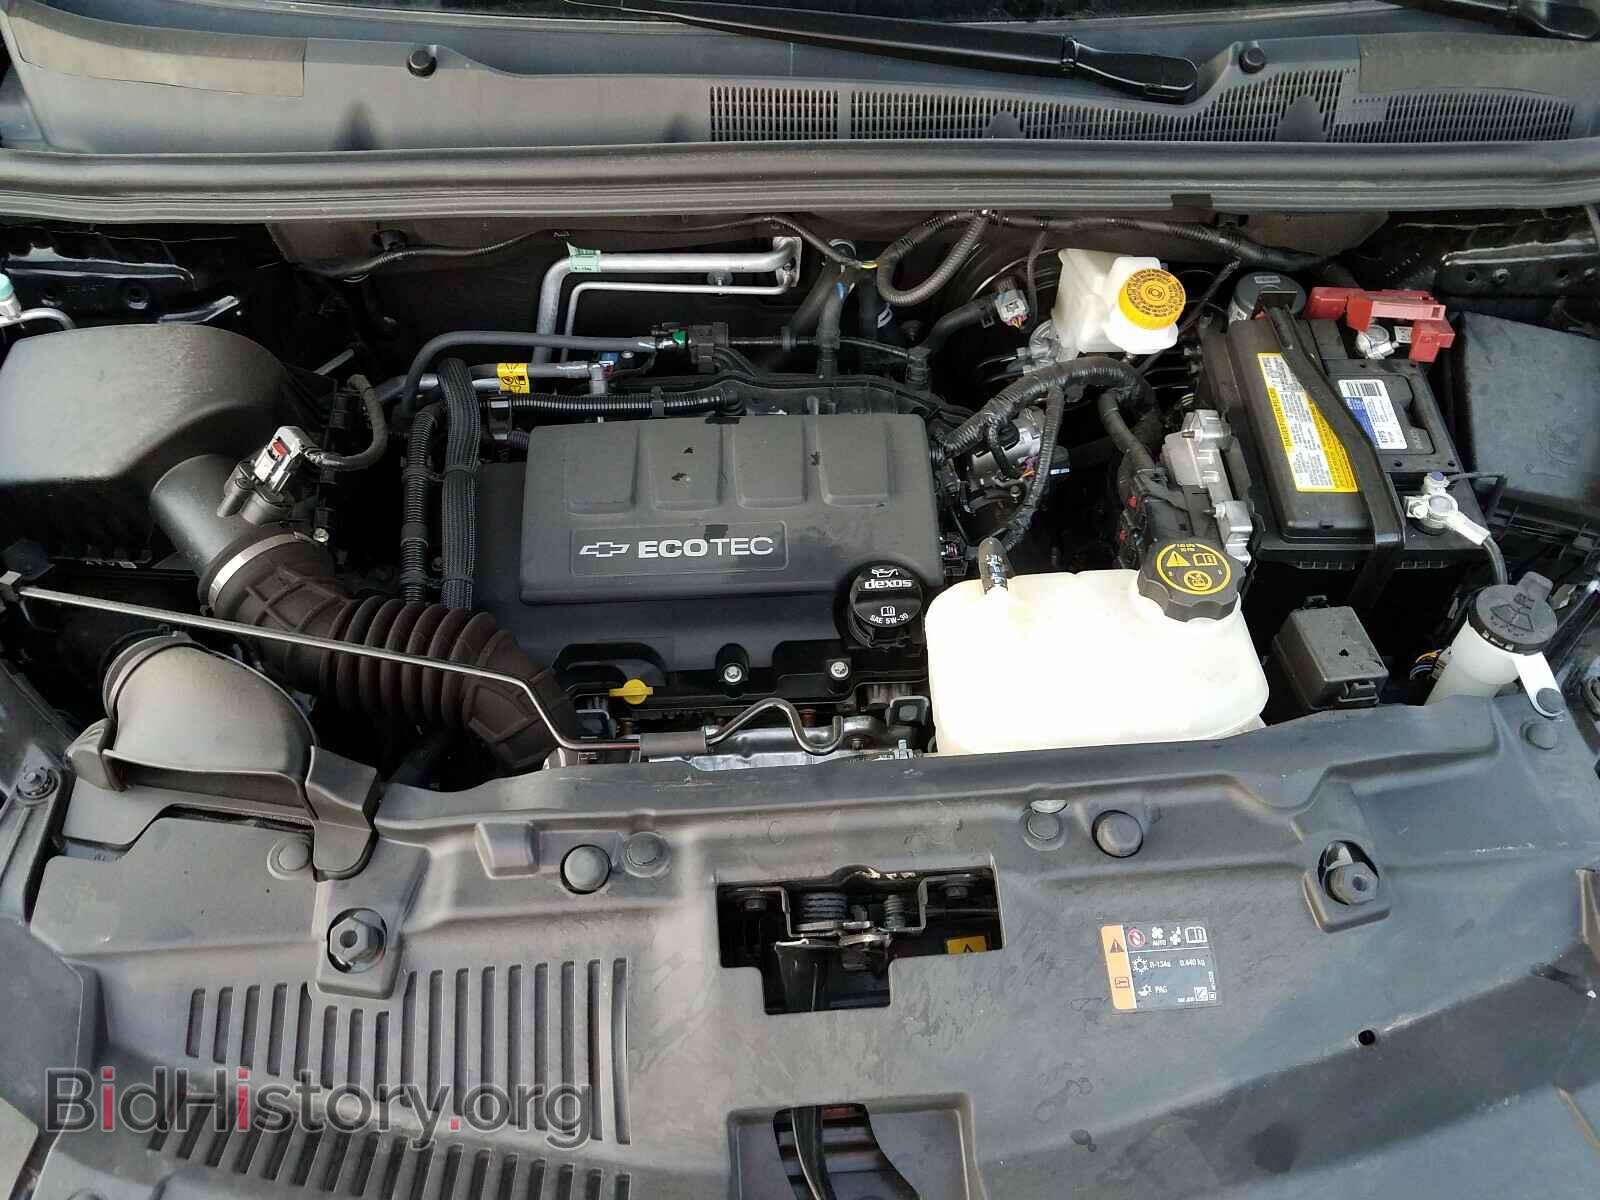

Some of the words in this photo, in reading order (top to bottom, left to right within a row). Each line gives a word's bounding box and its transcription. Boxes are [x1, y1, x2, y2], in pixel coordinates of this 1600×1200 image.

[638, 537, 774, 559] ECOTEC
[864, 578, 913, 590] dexos
[869, 614, 883, 624] SAE
[885, 612, 909, 625] 5W-30
[1154, 985, 1168, 993] PAG
